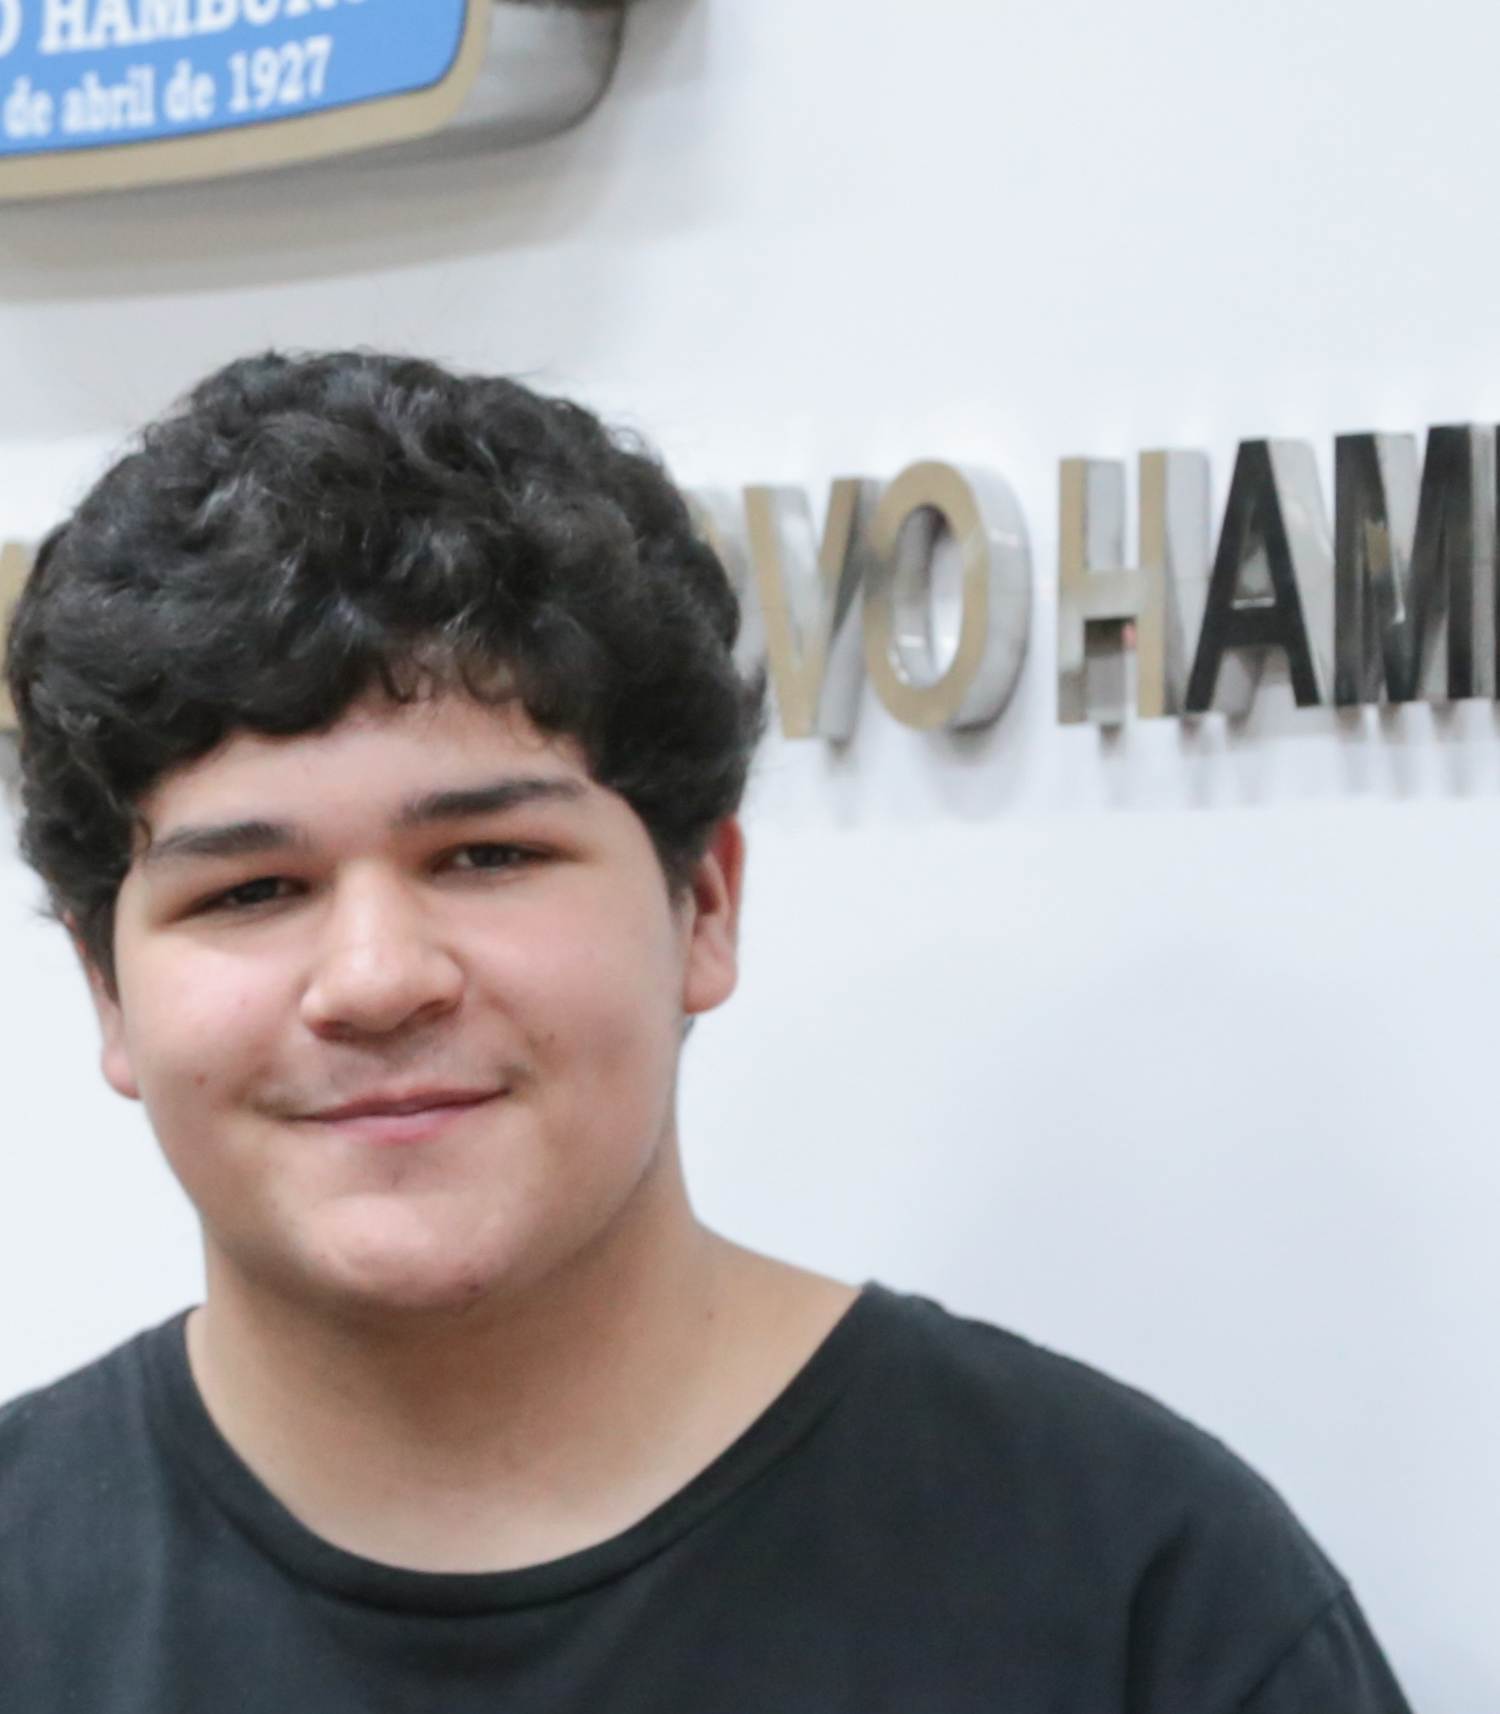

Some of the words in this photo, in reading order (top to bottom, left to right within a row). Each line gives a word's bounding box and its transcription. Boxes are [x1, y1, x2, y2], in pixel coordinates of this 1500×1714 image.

[4, 75, 53, 138] de
[62, 65, 156, 134] abril
[163, 58, 215, 122] de
[228, 34, 333, 113] 1927
